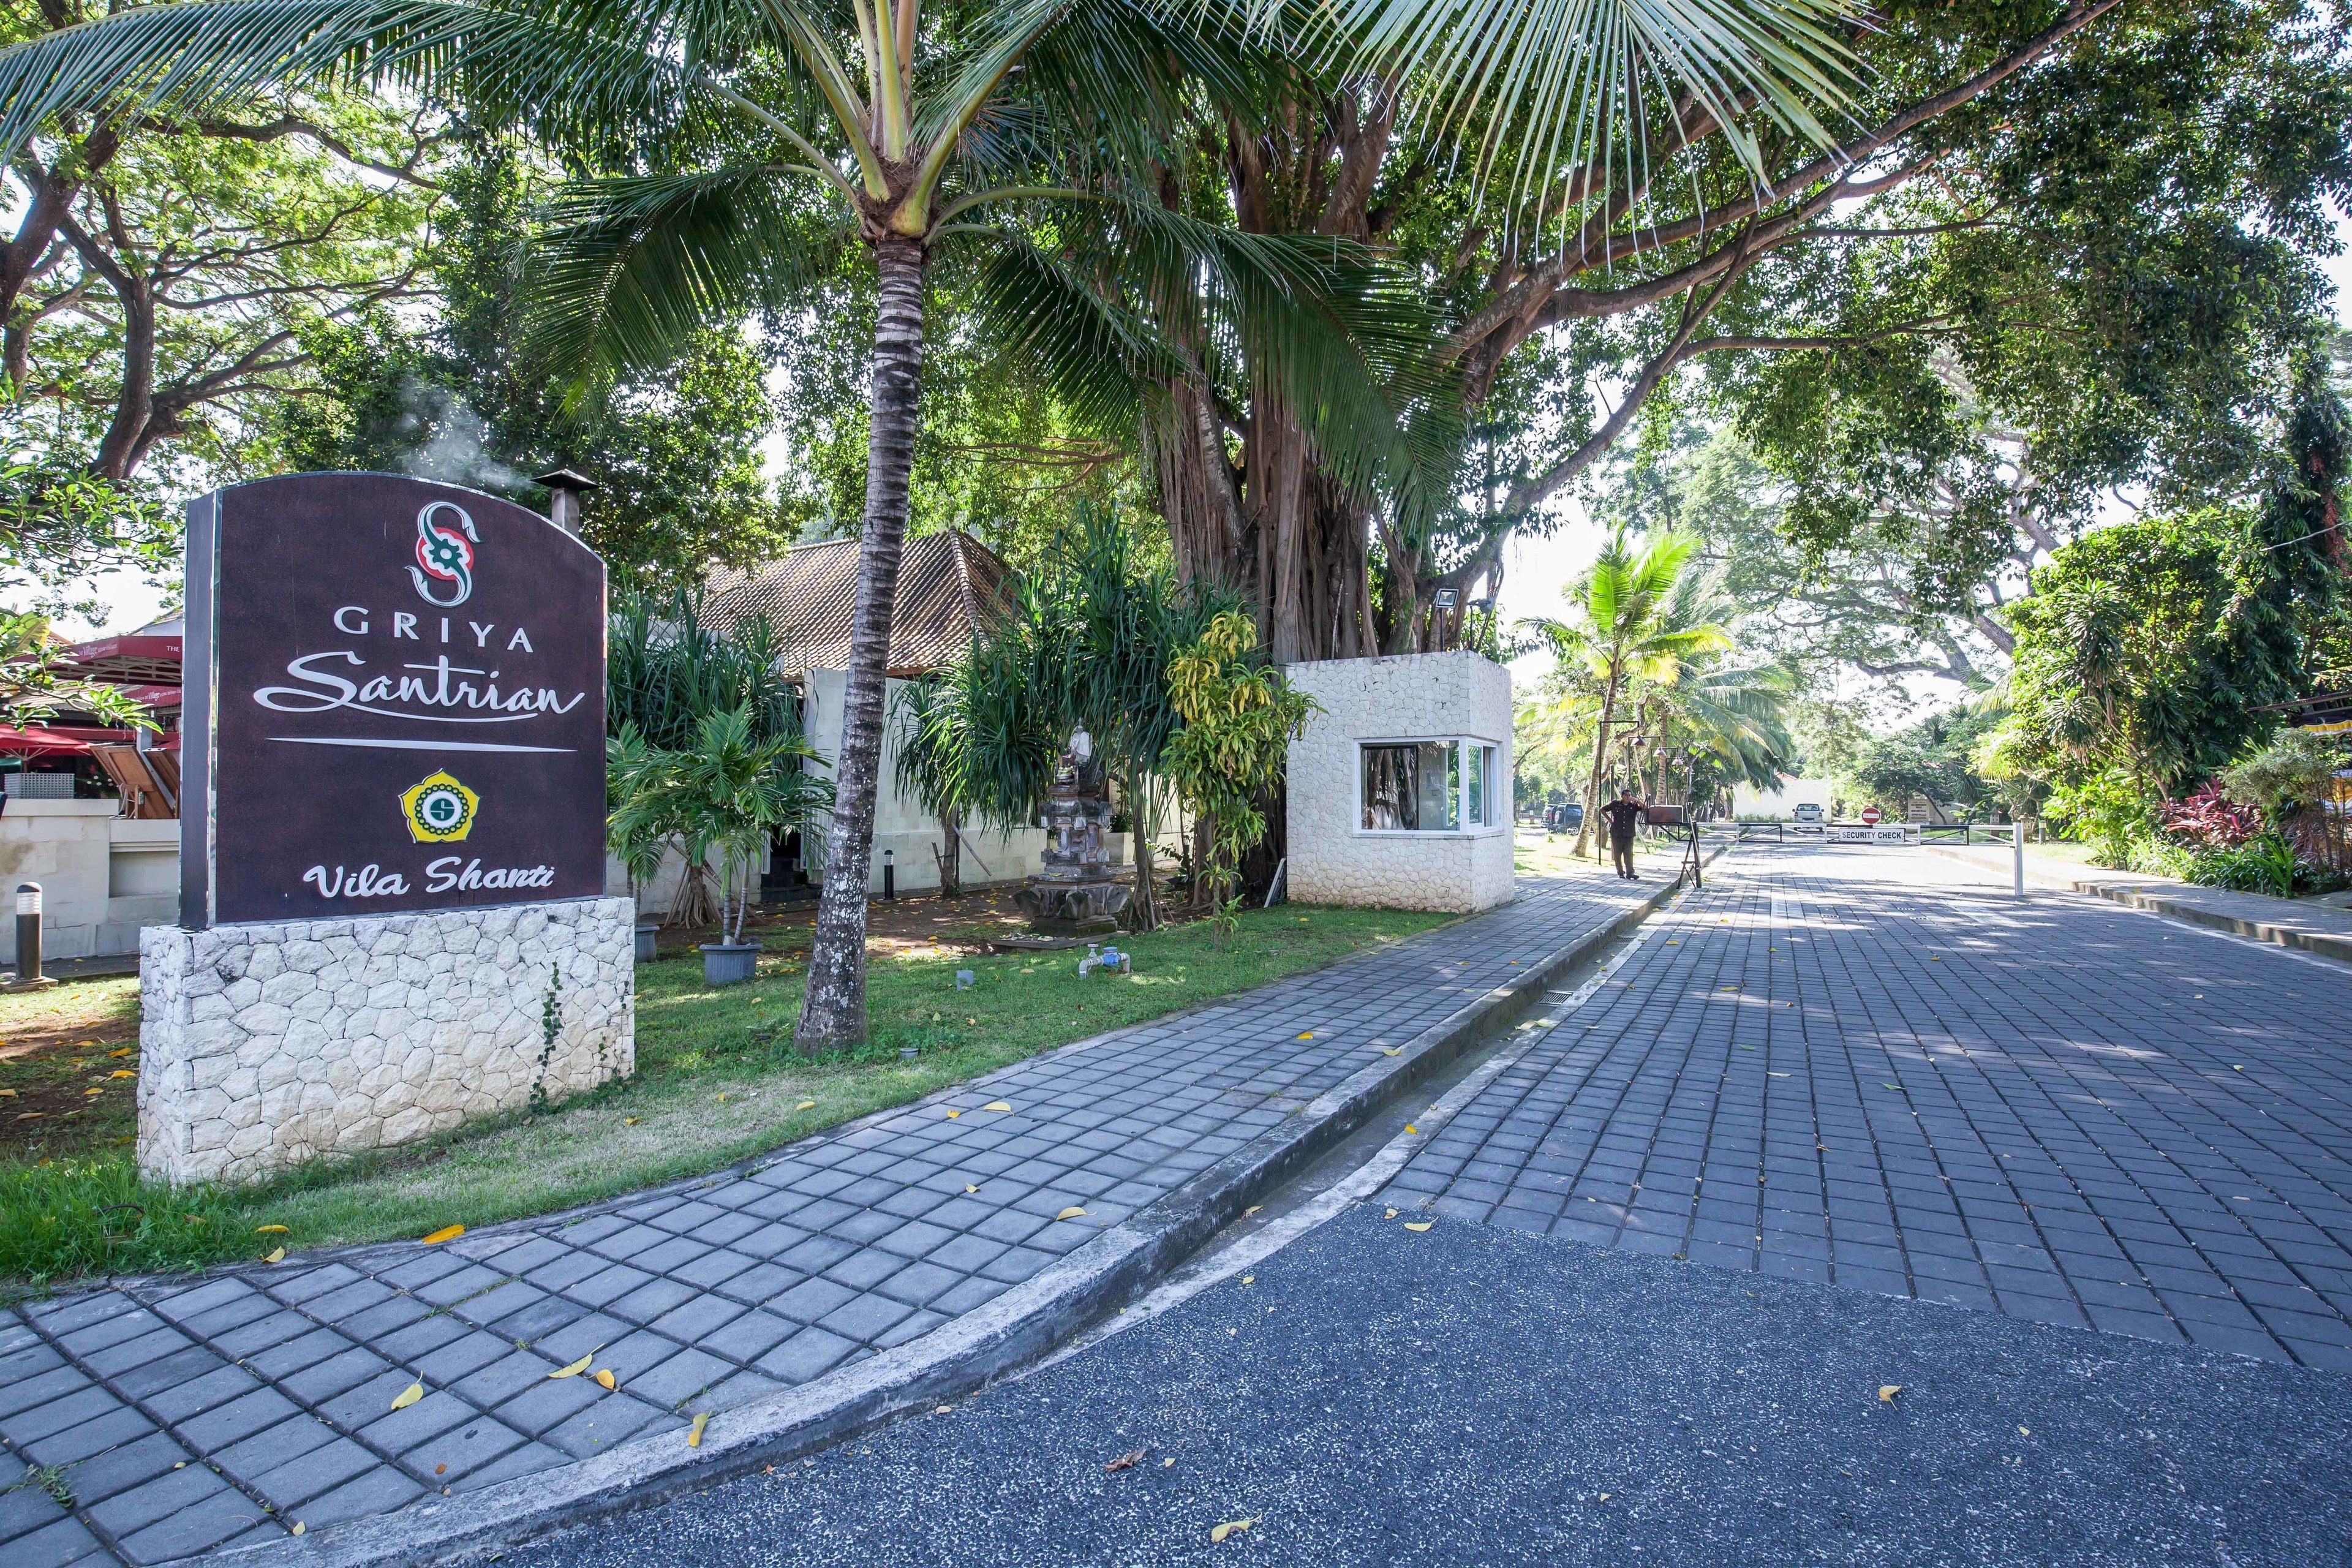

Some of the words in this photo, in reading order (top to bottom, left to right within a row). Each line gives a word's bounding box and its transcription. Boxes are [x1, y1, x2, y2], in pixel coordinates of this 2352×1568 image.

[334, 606, 533, 652] GRIYA
[253, 651, 586, 723] Santrian
[303, 864, 410, 898] Vila
[426, 856, 554, 893] Shanti
